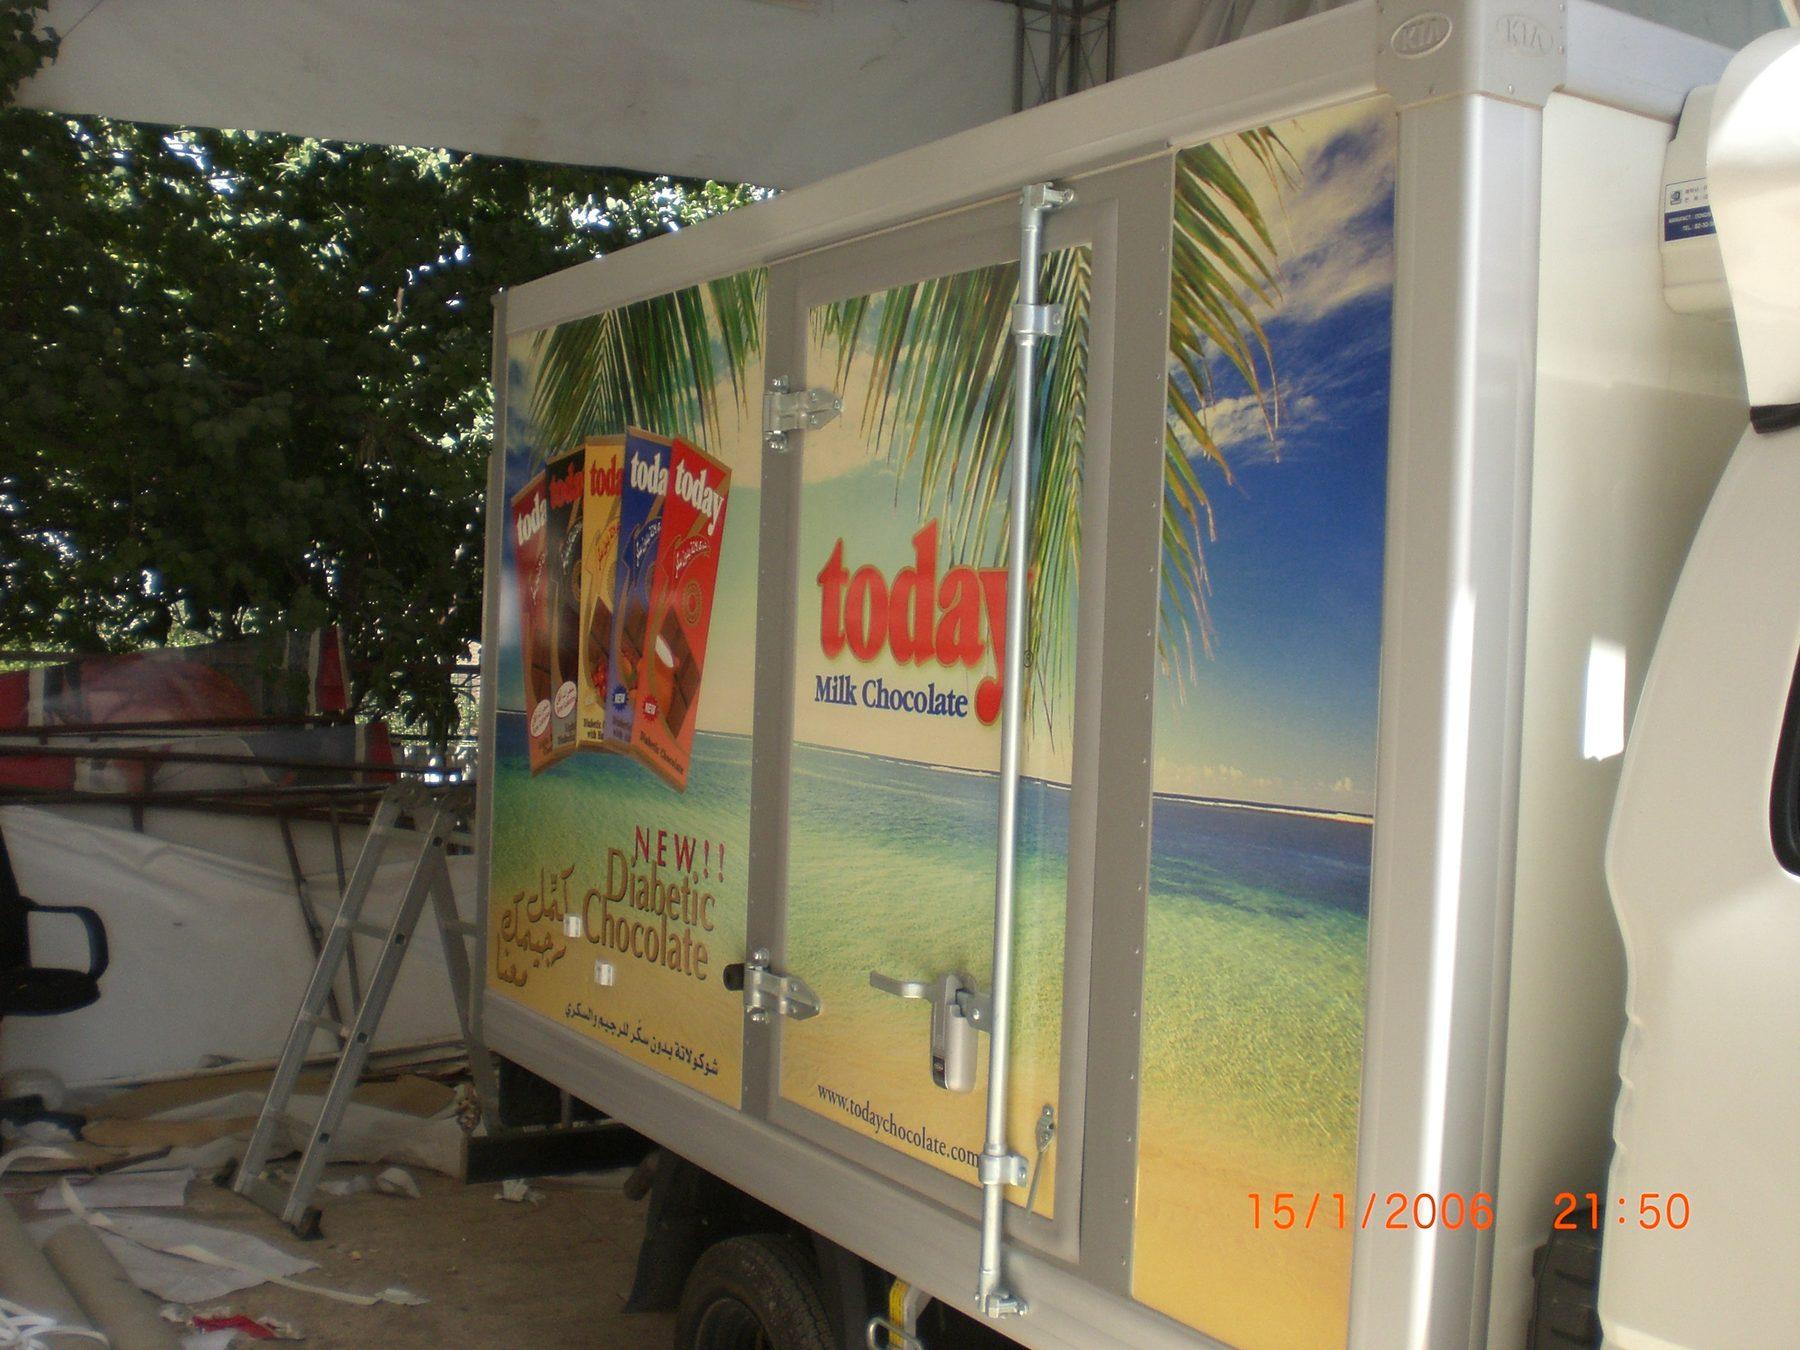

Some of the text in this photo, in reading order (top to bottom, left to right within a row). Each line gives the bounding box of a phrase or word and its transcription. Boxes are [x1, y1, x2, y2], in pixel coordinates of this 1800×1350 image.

[1505, 17, 1544, 50] KIA
[674, 458, 724, 536] today
[816, 517, 1034, 726] today
[814, 674, 969, 718] Milk Chocolate
[605, 847, 716, 932] Diabetic
[631, 825, 725, 883] NEW!!
[582, 888, 709, 981] Chocolate
[649, 1036, 673, 1061] بدون
[817, 1084, 980, 1169] www.todaychocolate.com
